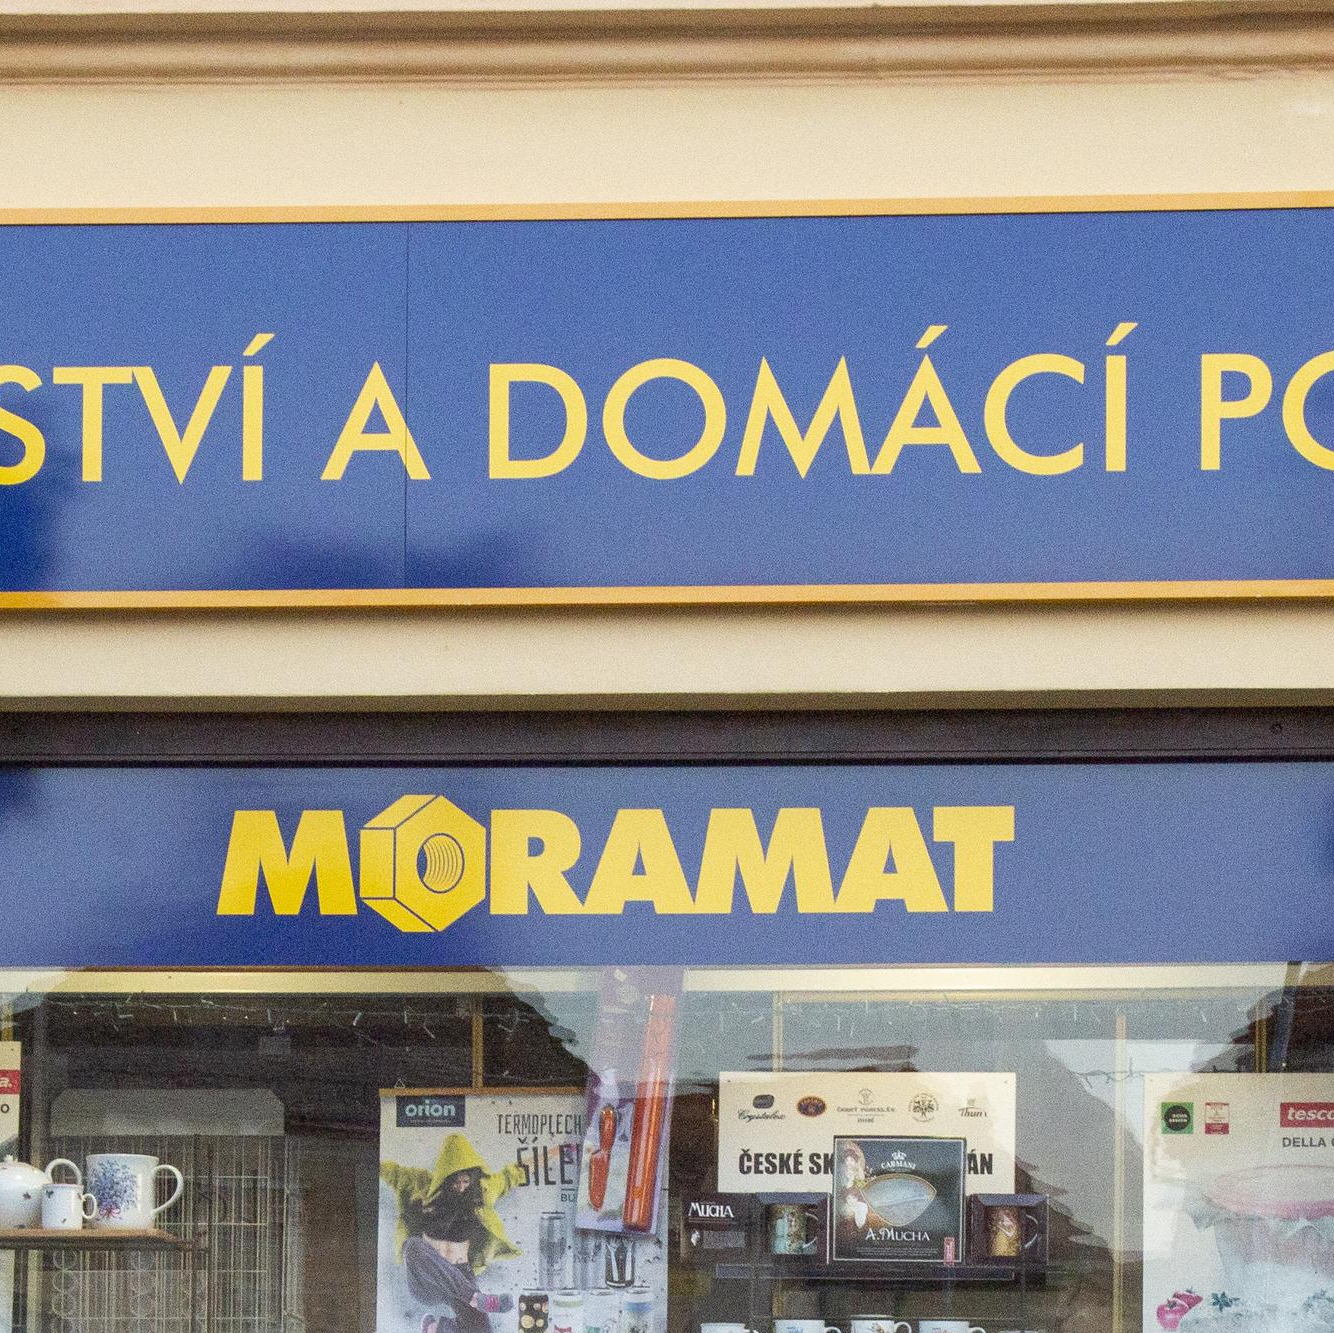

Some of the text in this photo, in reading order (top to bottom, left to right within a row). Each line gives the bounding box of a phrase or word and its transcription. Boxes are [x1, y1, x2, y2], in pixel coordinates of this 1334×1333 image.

[321, 363, 432, 482] A
[489, 323, 1137, 481] DOMÁCÍ
[405, 1100, 456, 1117] orion
[1282, 1136, 1327, 1148] DELLA
[739, 1148, 804, 1175] ČESKÉ
[688, 1202, 734, 1218] MUCHA
